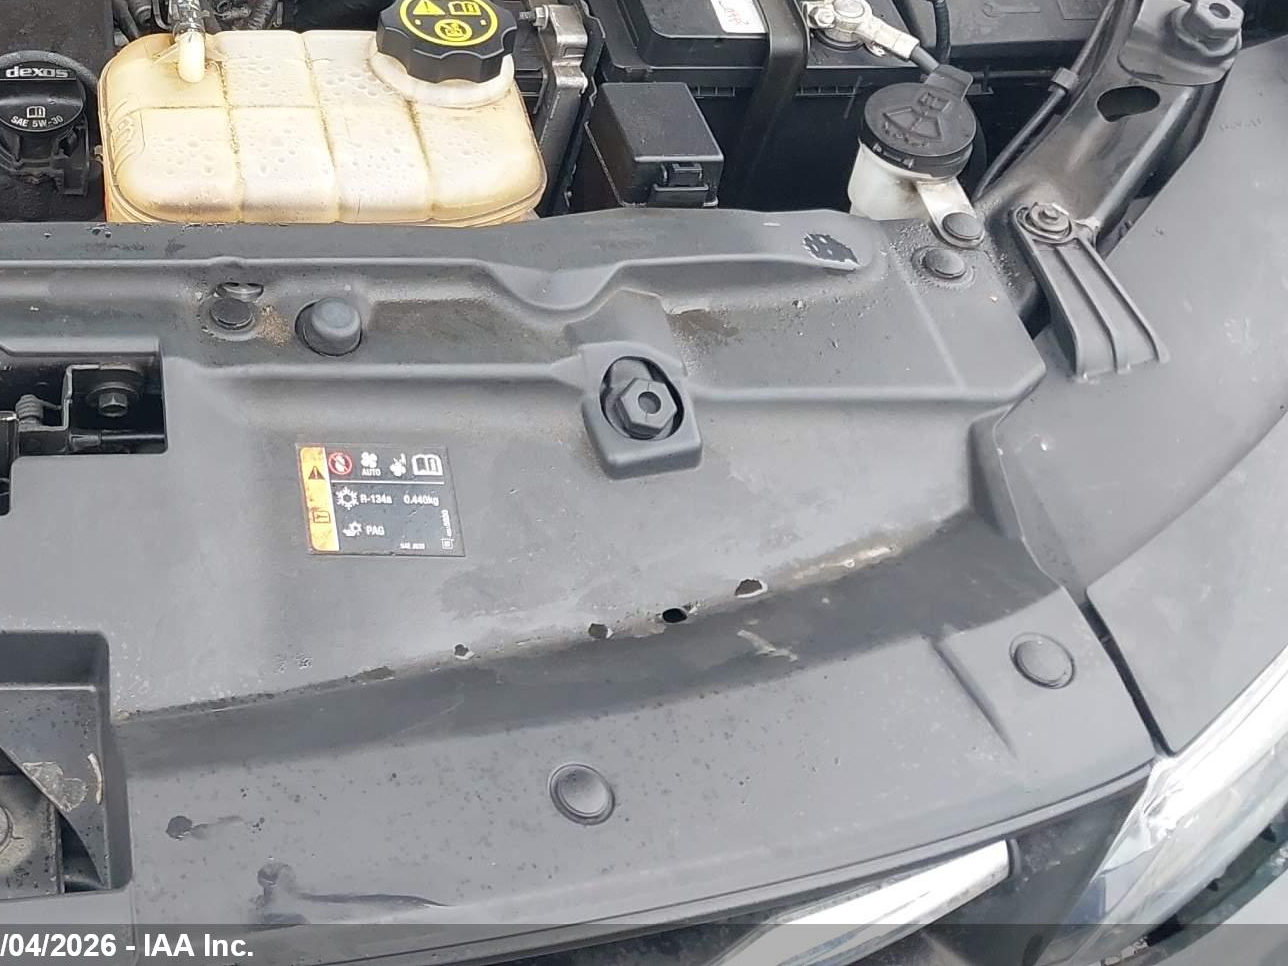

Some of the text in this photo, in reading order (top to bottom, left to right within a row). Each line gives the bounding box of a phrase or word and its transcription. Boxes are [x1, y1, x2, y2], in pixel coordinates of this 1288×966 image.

[5, 65, 69, 78] dexos
[10, 115, 64, 128] SAE 5W-30
[362, 468, 381, 476] AUTO
[360, 494, 440, 507] R-134a 0.440kg
[365, 525, 385, 536] PAG
